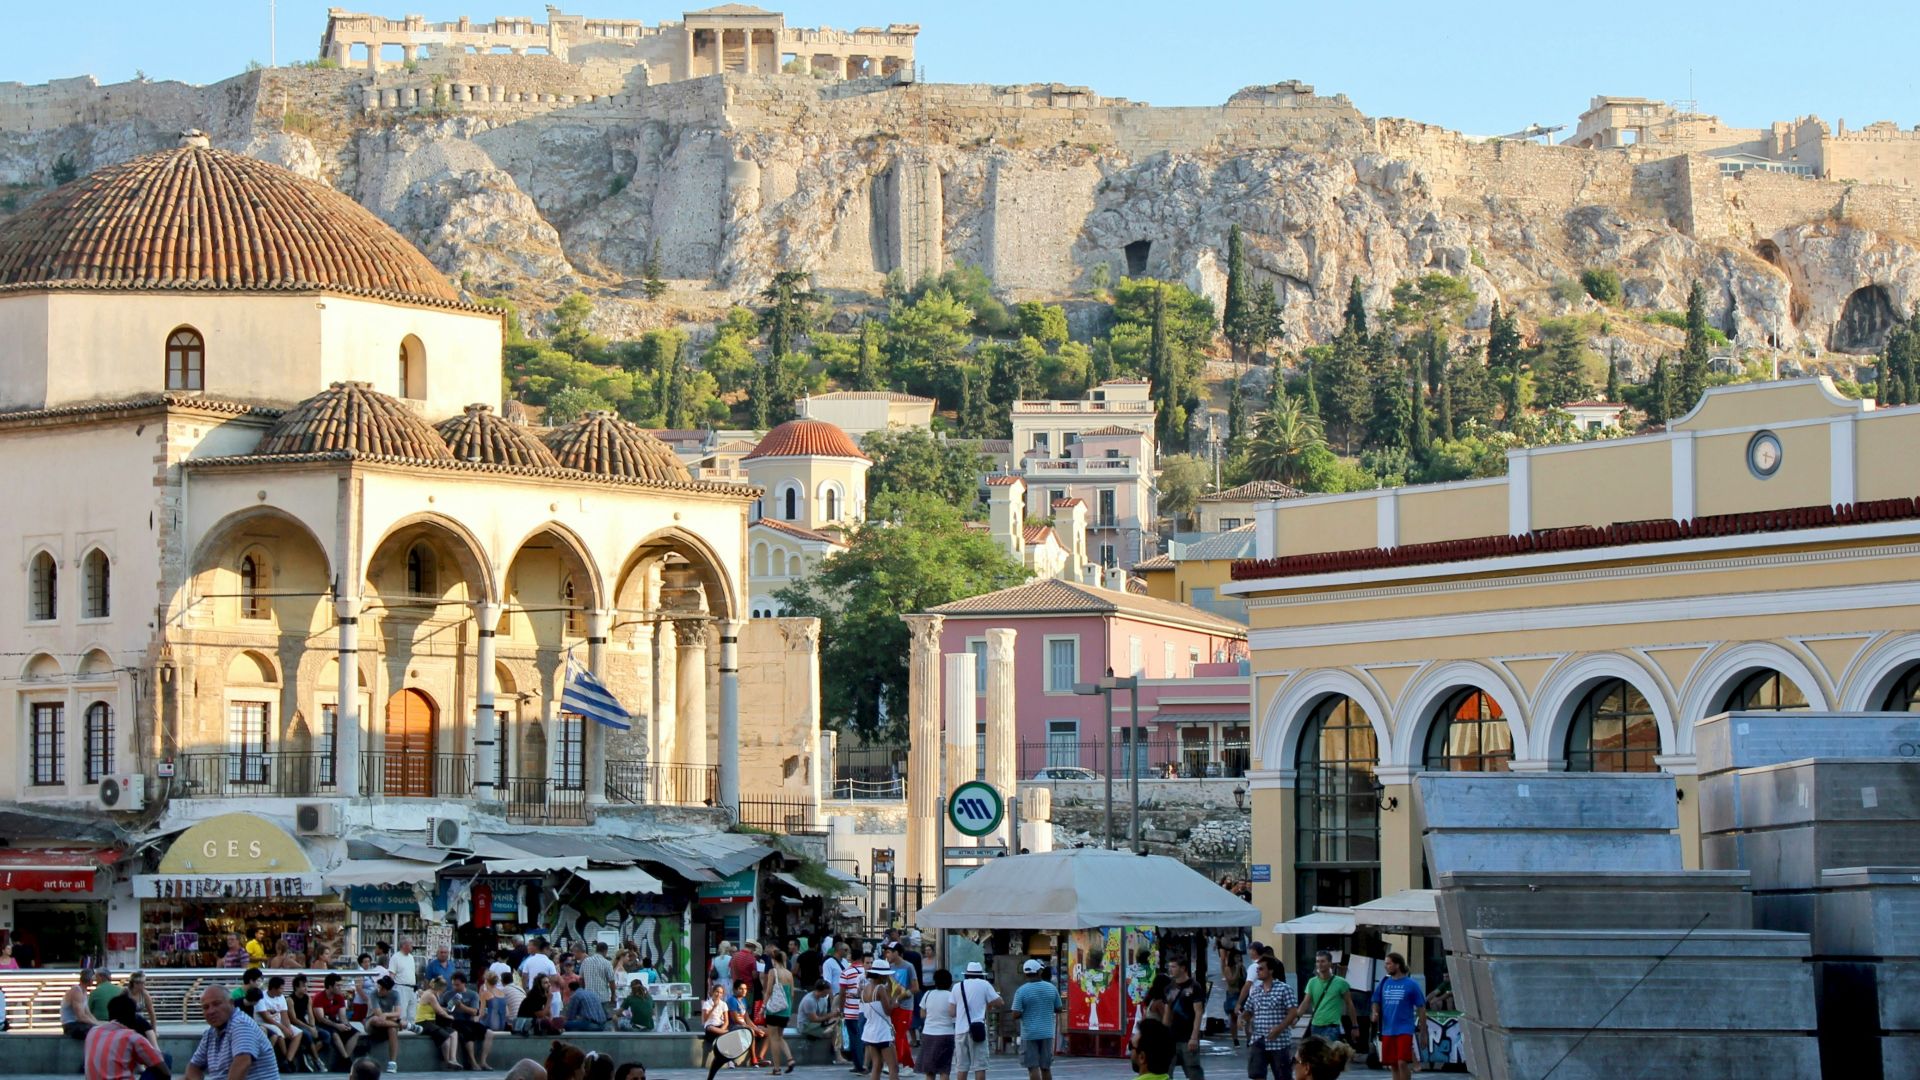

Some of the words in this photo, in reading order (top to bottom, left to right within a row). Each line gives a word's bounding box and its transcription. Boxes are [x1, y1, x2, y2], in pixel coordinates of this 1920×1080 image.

[203, 840, 261, 858] GES
[43, 880, 57, 889] art
[58, 879, 73, 889] for
[74, 880, 86, 889] all
